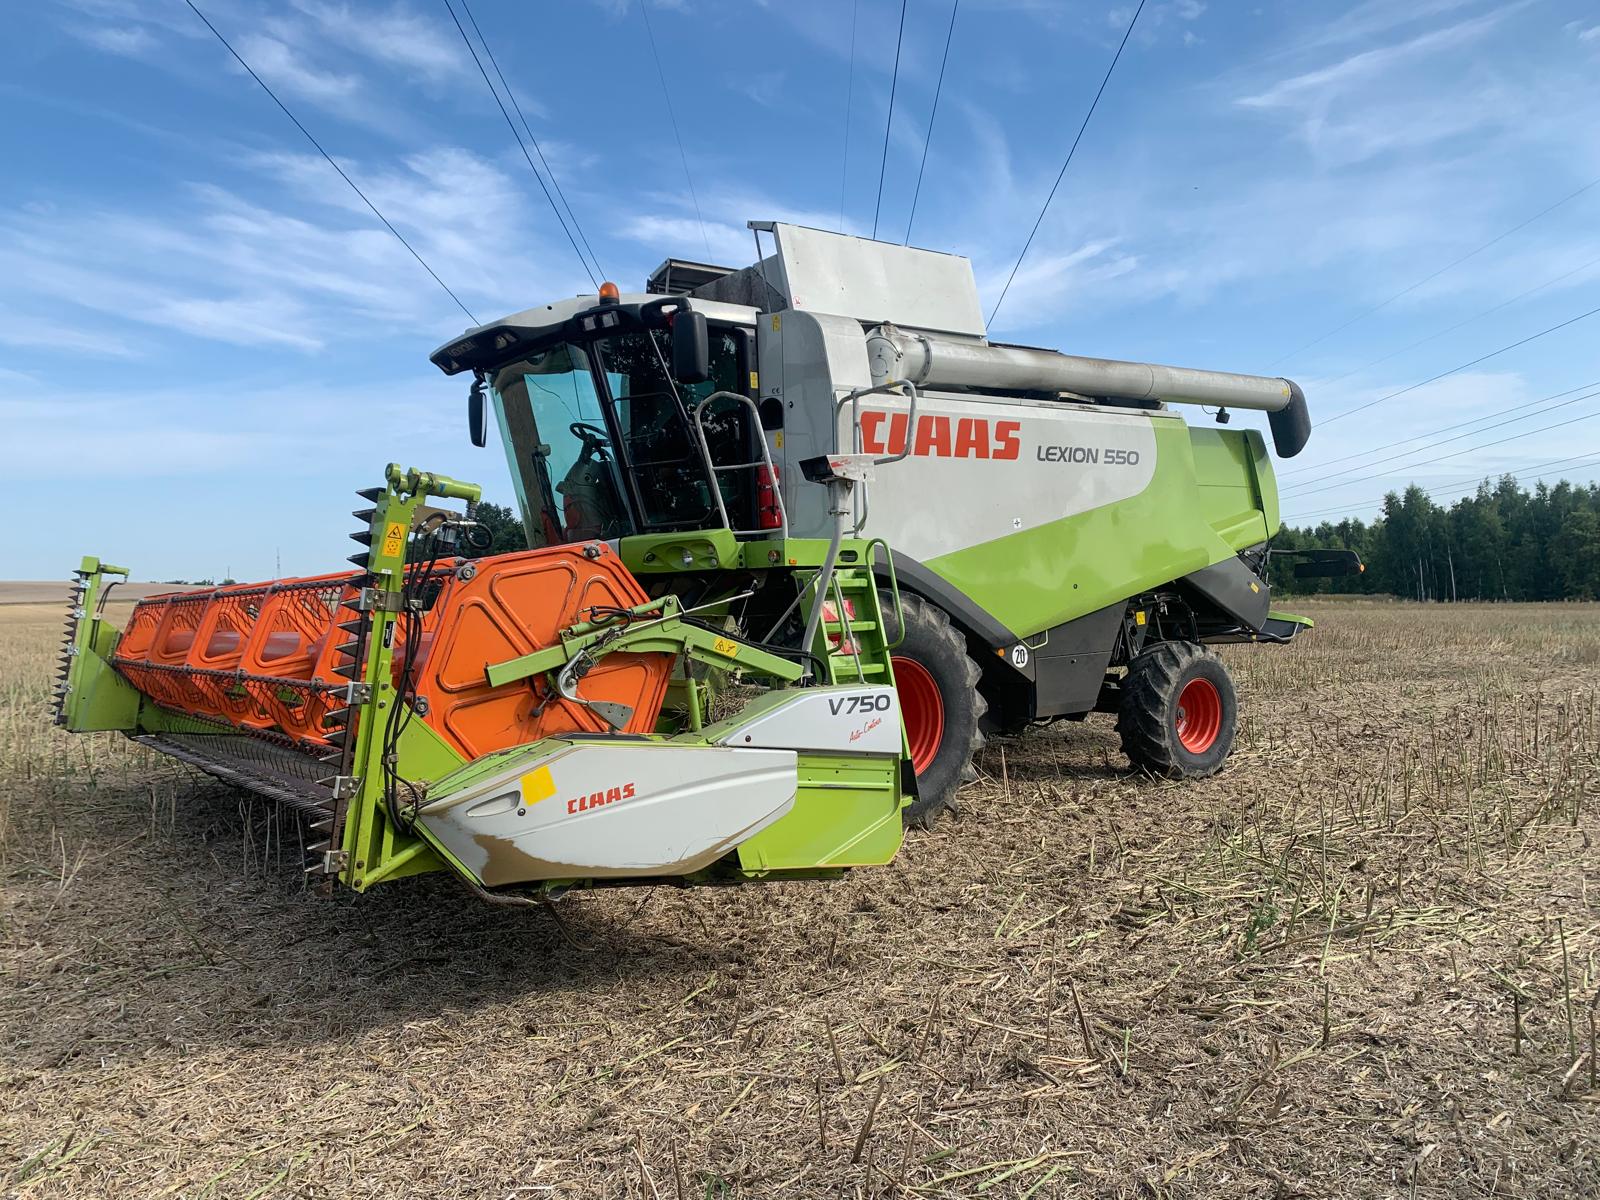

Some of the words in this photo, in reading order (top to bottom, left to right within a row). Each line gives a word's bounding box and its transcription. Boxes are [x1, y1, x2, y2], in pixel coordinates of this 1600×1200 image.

[860, 411, 1020, 460] CLAAS
[1036, 445, 1099, 464] LEXION
[1104, 449, 1140, 466] 550
[1015, 648, 1026, 664] 20
[828, 694, 891, 716] V750
[567, 782, 635, 815] CLAAS
